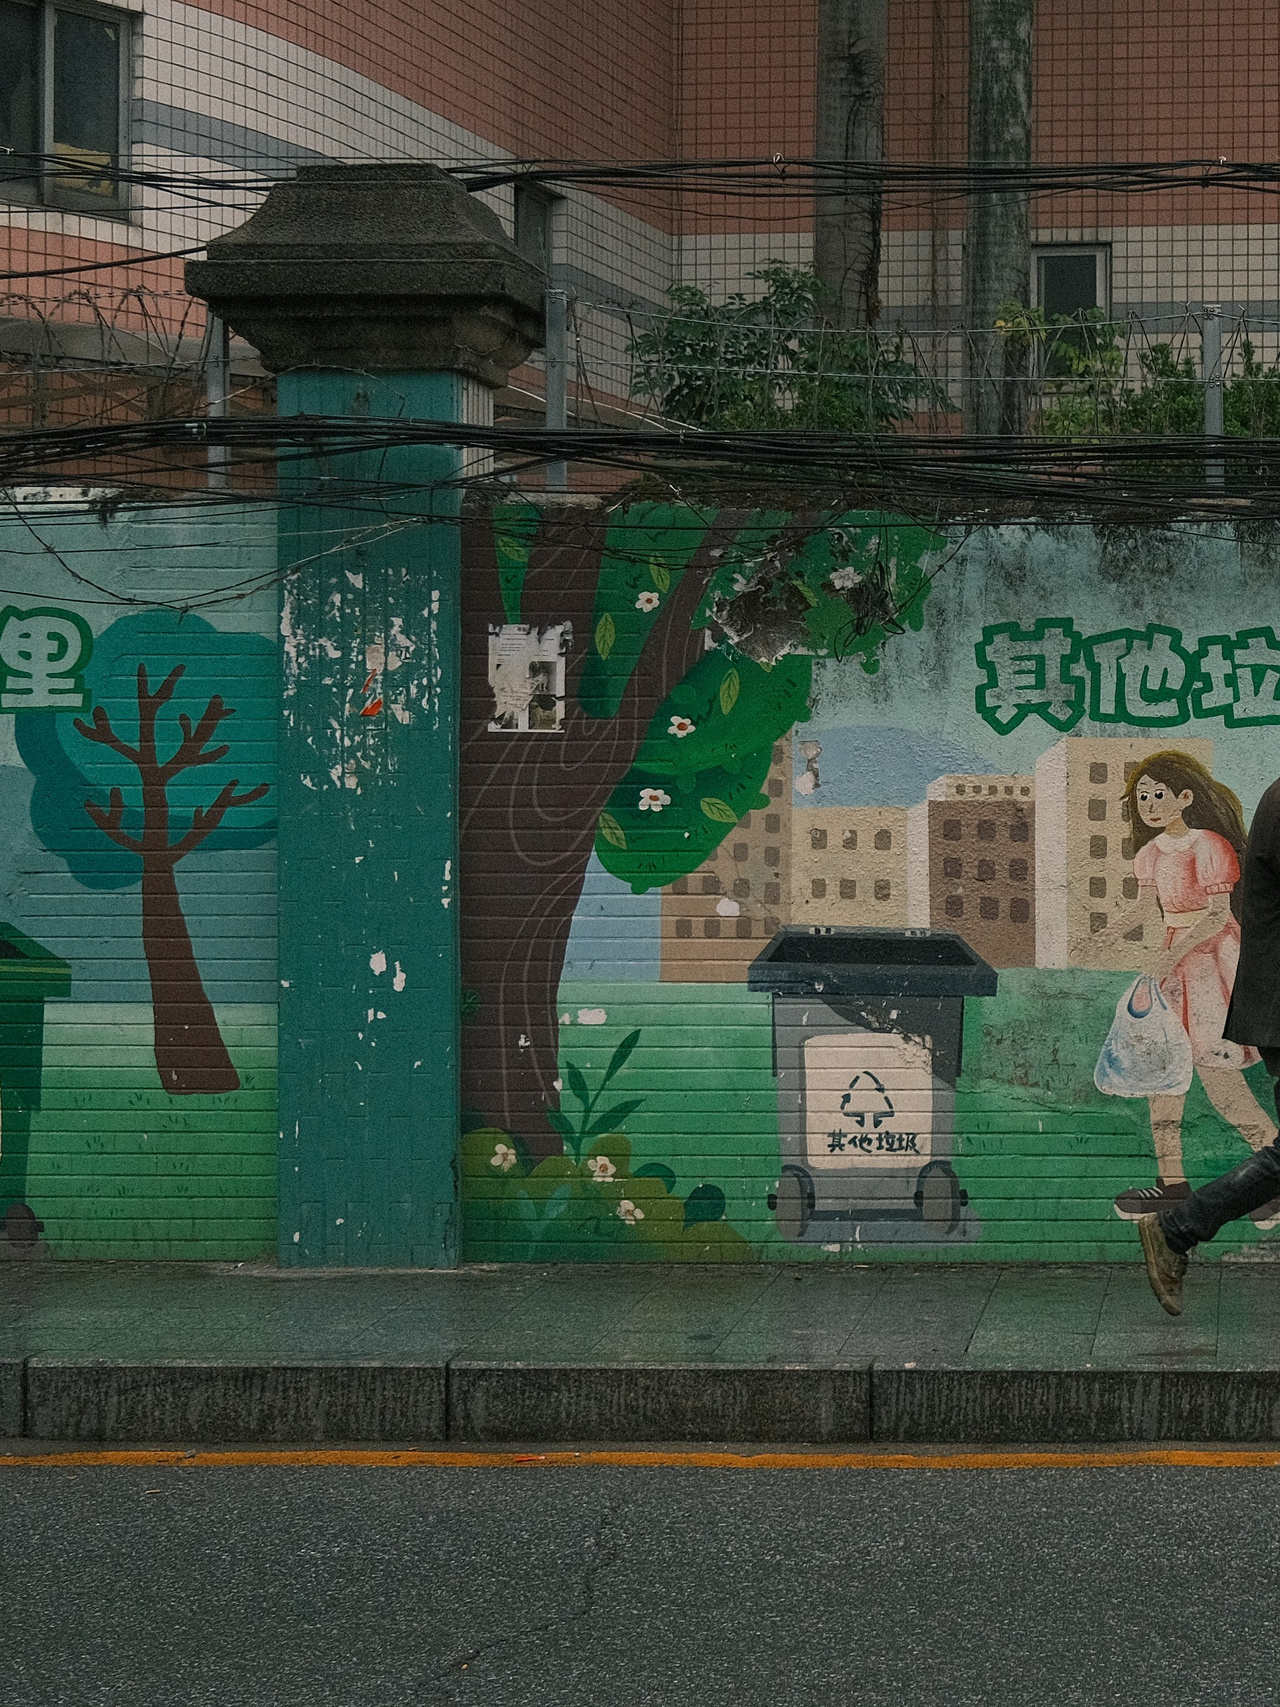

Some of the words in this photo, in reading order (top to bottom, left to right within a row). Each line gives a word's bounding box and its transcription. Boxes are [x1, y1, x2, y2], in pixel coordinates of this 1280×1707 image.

[0, 605, 93, 714] 里
[827, 1128, 920, 1154] 其他垃圾
